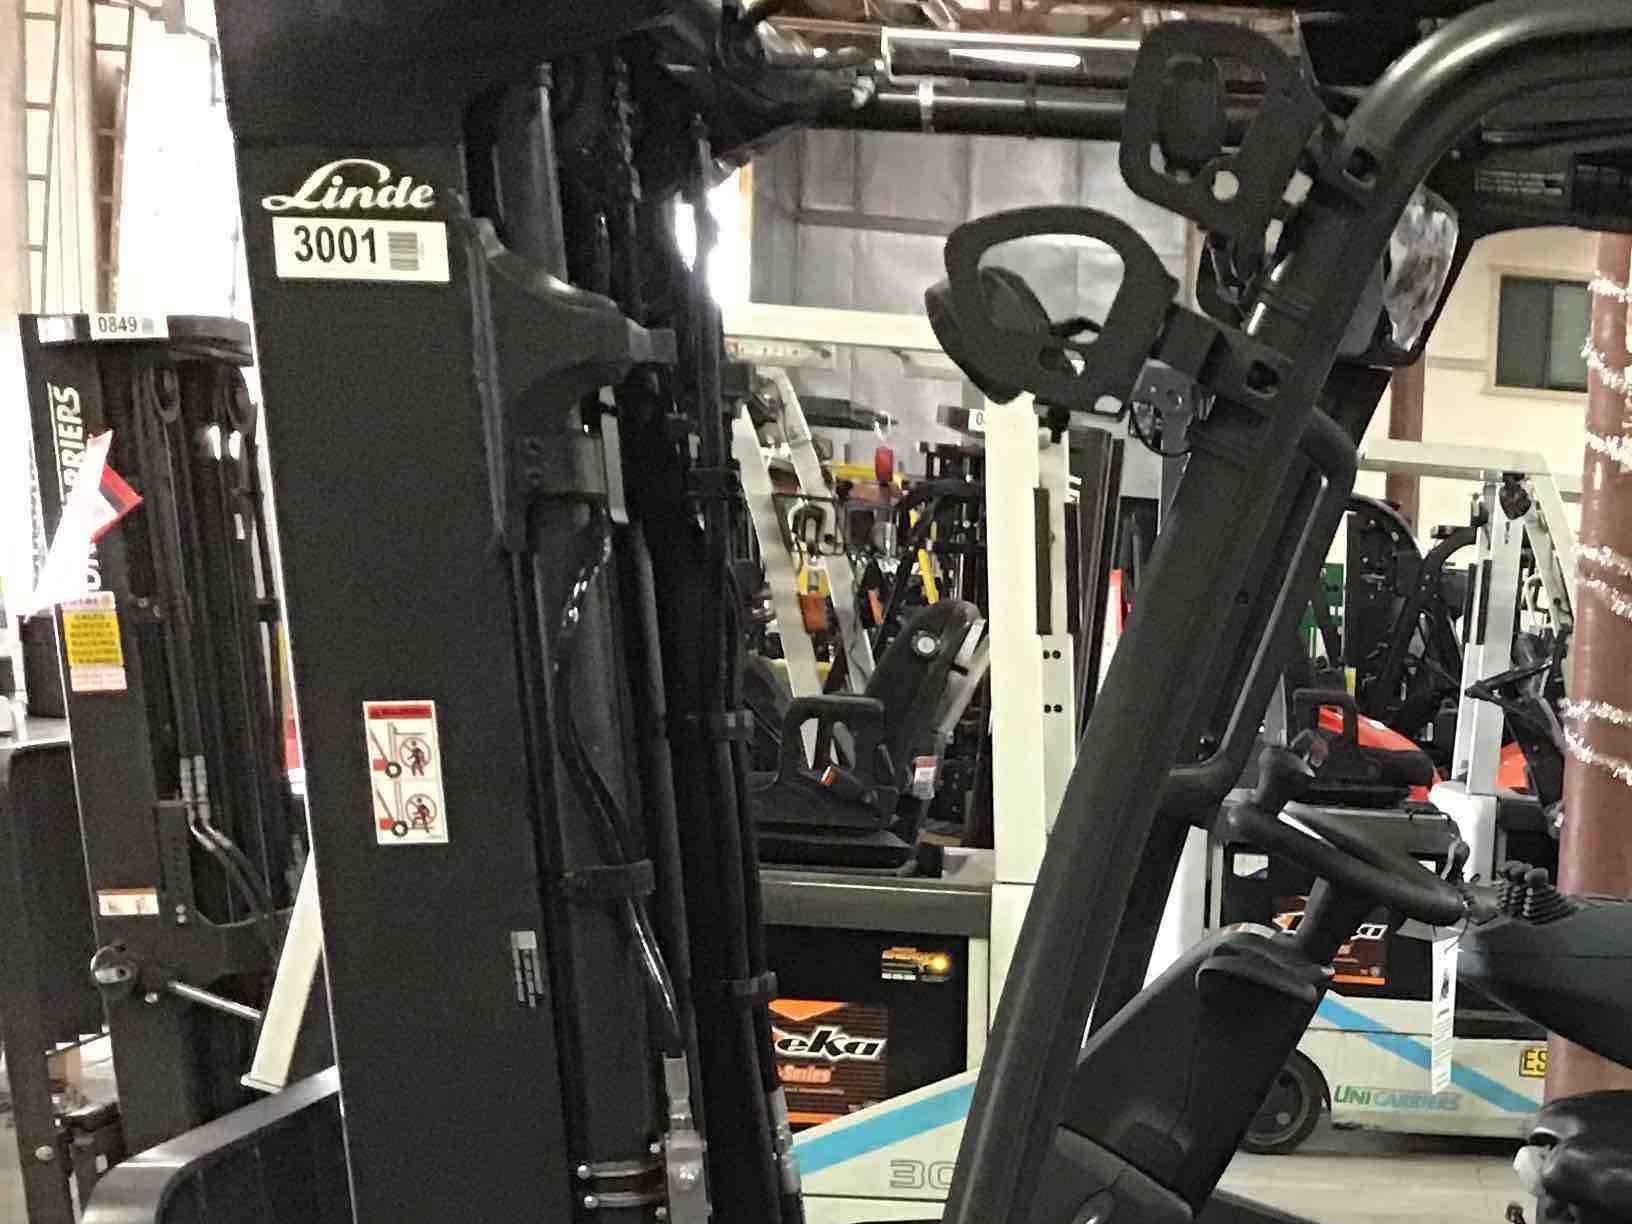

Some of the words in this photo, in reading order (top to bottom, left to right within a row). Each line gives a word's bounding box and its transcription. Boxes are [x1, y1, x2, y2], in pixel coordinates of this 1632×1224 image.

[262, 158, 435, 211] Linde
[293, 225, 376, 263] 3001
[98, 315, 137, 333] 0849
